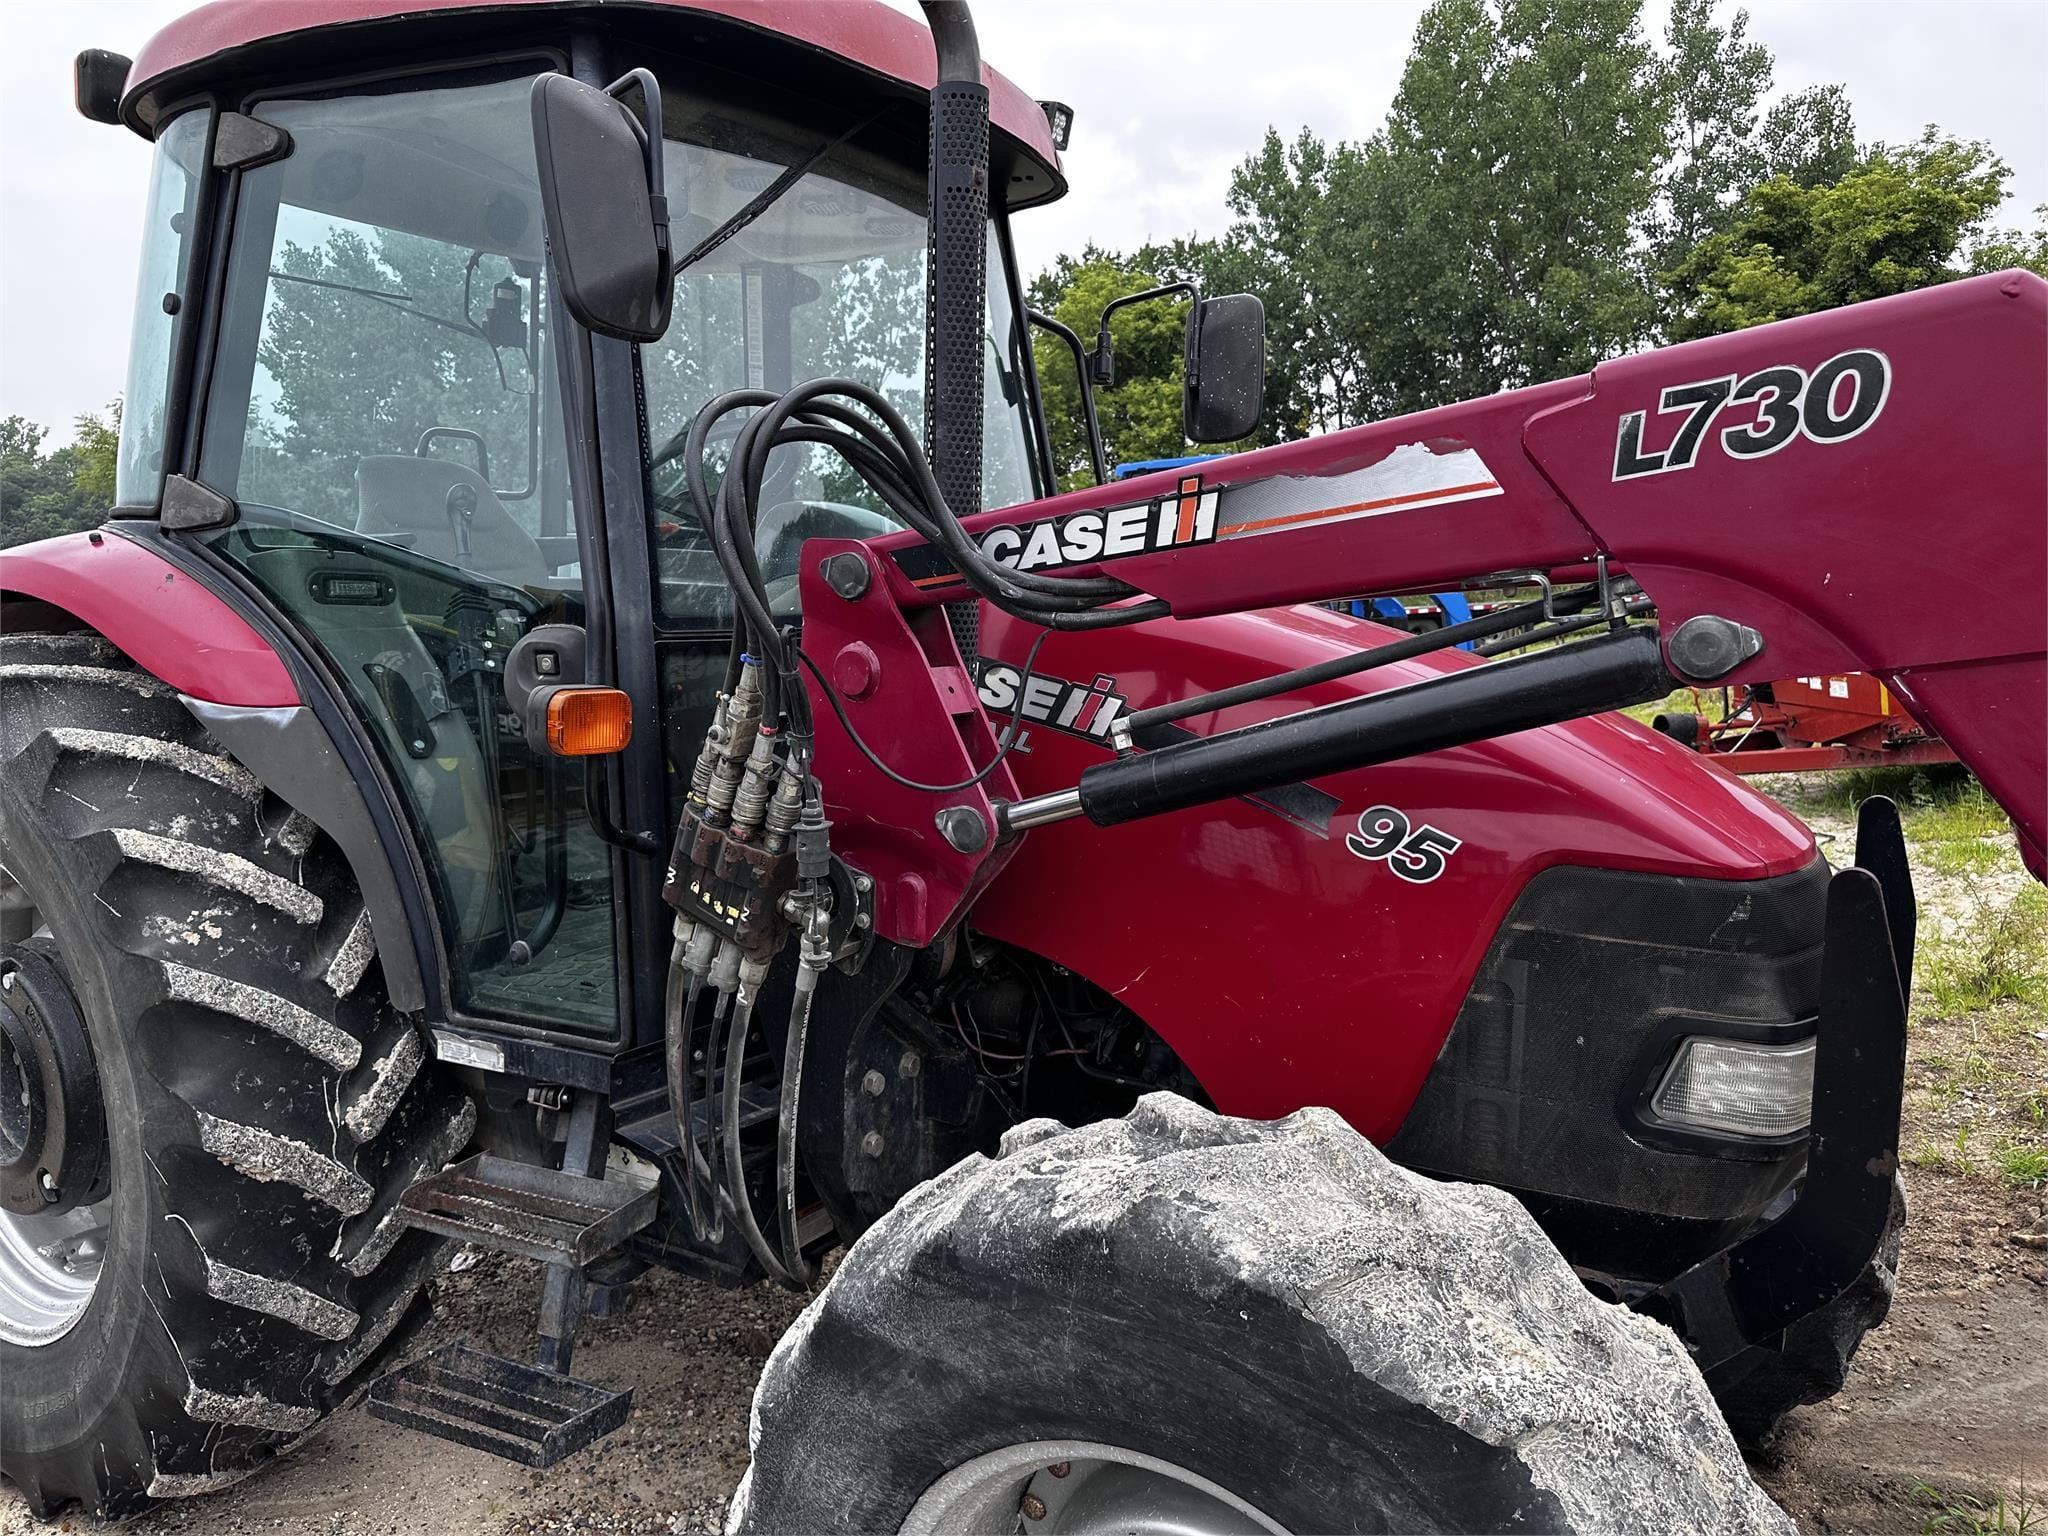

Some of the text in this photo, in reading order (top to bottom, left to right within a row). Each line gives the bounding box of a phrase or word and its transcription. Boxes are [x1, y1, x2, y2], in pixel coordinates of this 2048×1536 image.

[1612, 349, 1892, 482] L730
[979, 504, 1149, 570] CASE
[978, 666, 1064, 721] SE
[1345, 804, 1463, 884] 95
